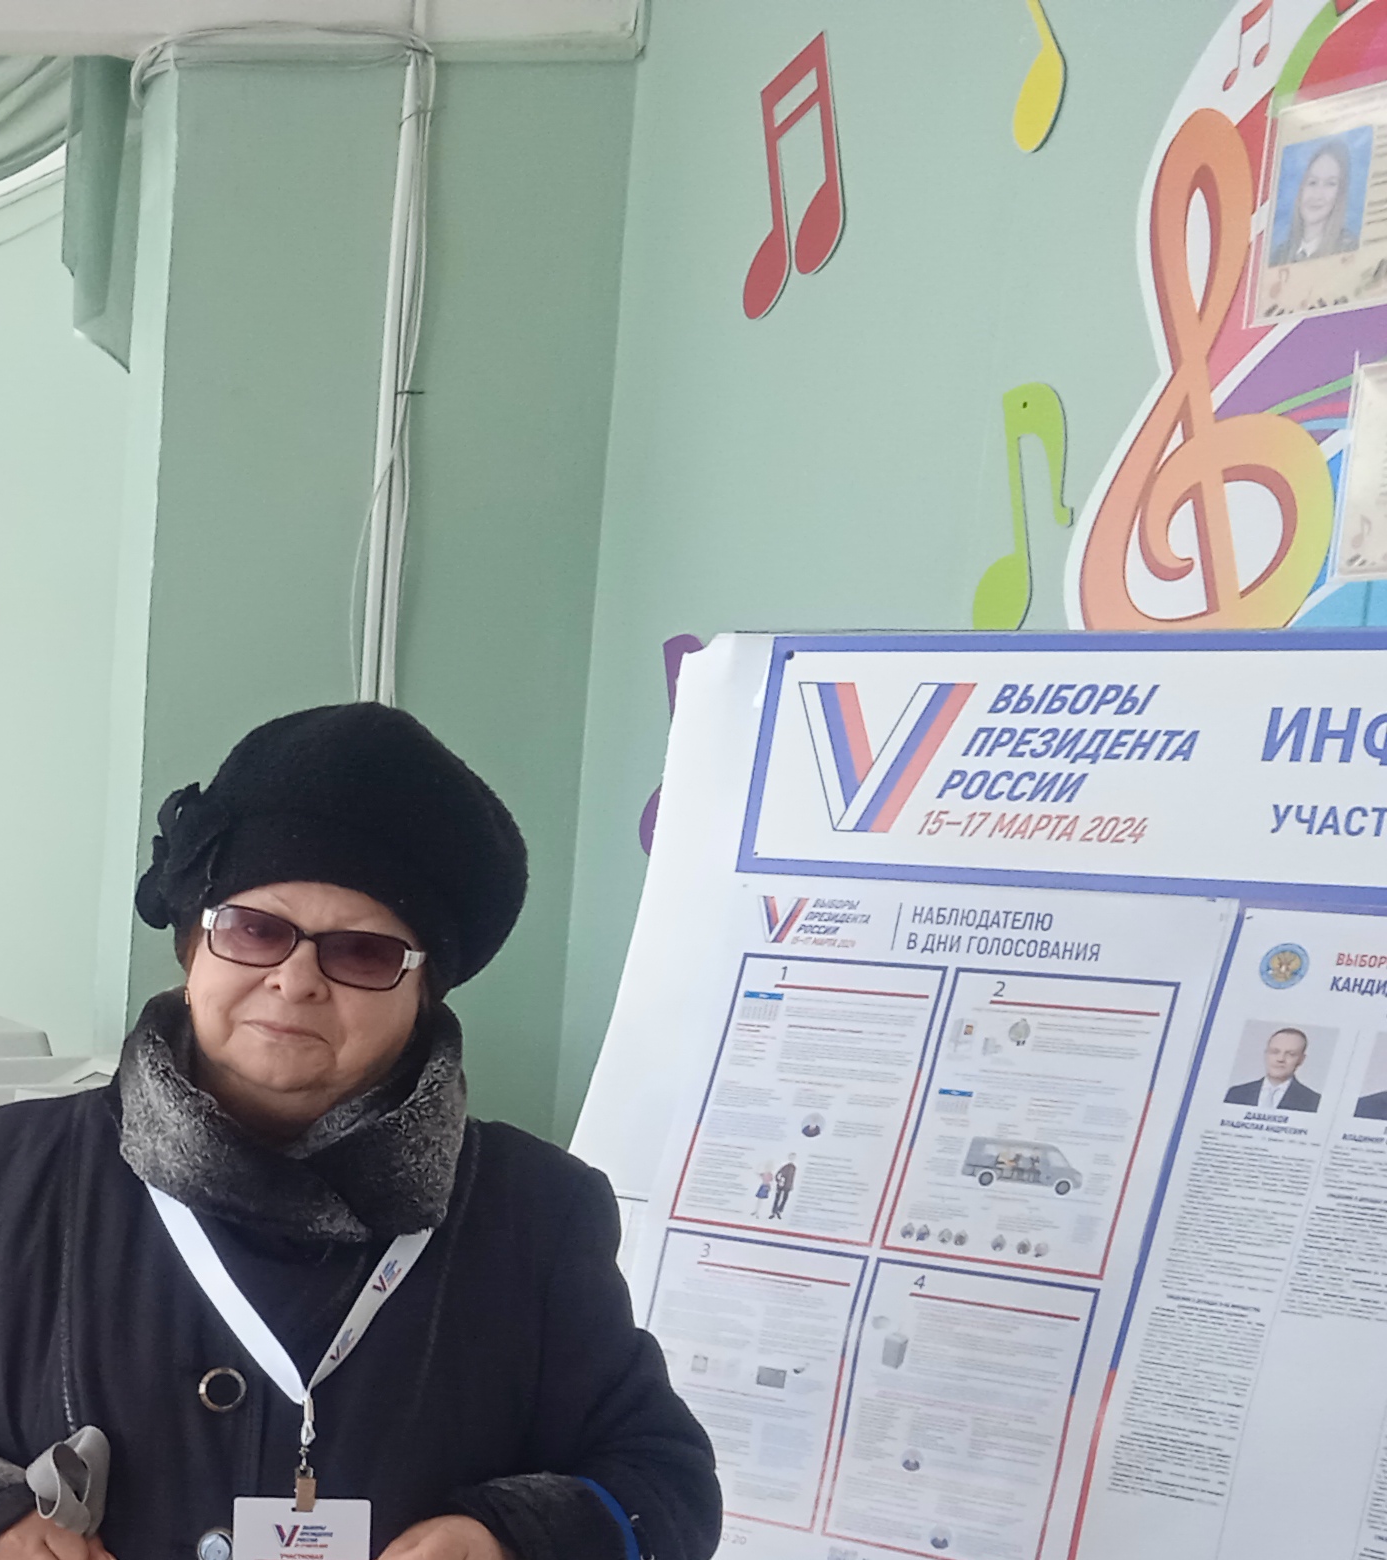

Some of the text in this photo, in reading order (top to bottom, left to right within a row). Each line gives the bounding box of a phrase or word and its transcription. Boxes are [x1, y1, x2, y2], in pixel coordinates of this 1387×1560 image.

[986, 683, 1161, 716] ВЫБОРЫ
[961, 727, 1200, 764] ПРЕЗИДЕНТА
[935, 769, 1089, 804] РОССИИ
[986, 813, 1081, 842] МАРТА
[1078, 815, 1150, 845] 2024
[804, 911, 872, 925] ПРЕЗИДЕНТА
[911, 905, 1055, 932] НАБЛЮДАТЕЛЮ
[796, 924, 841, 936] РОССИИ
[906, 932, 1102, 963] В ДНИ ГОЛОСОВАНИЯ
[780, 965, 789, 981] 1
[992, 980, 1007, 998] 2
[699, 1242, 712, 1258] 3
[912, 1273, 926, 1290] 4
